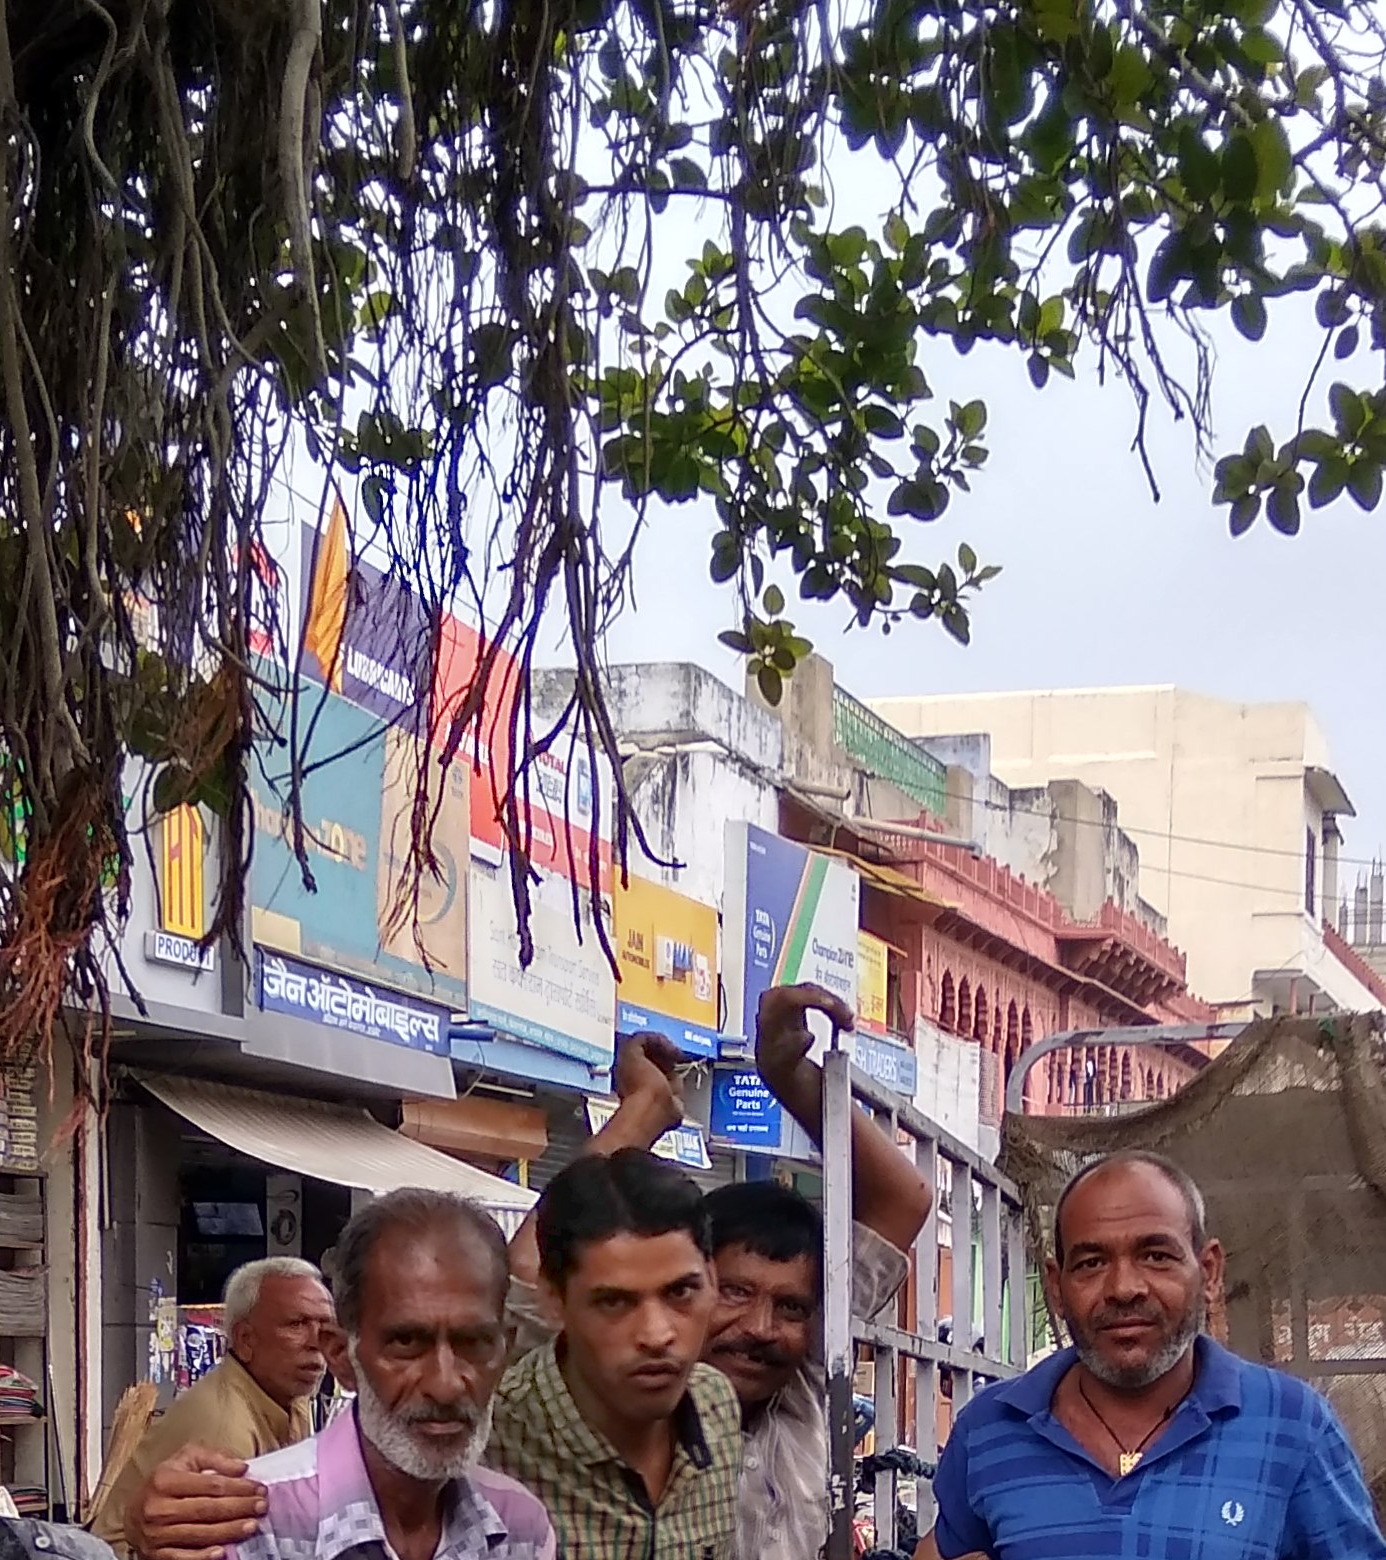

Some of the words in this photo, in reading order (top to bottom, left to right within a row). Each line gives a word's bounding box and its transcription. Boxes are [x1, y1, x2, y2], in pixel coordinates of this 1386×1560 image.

[158, 936, 211, 968] PRODUT
[263, 958, 306, 1008] जैन
[306, 973, 441, 1043] ऑटोमोबाइल्स
[728, 1086, 770, 1098] Genuine
[735, 1098, 761, 1110] Parts
